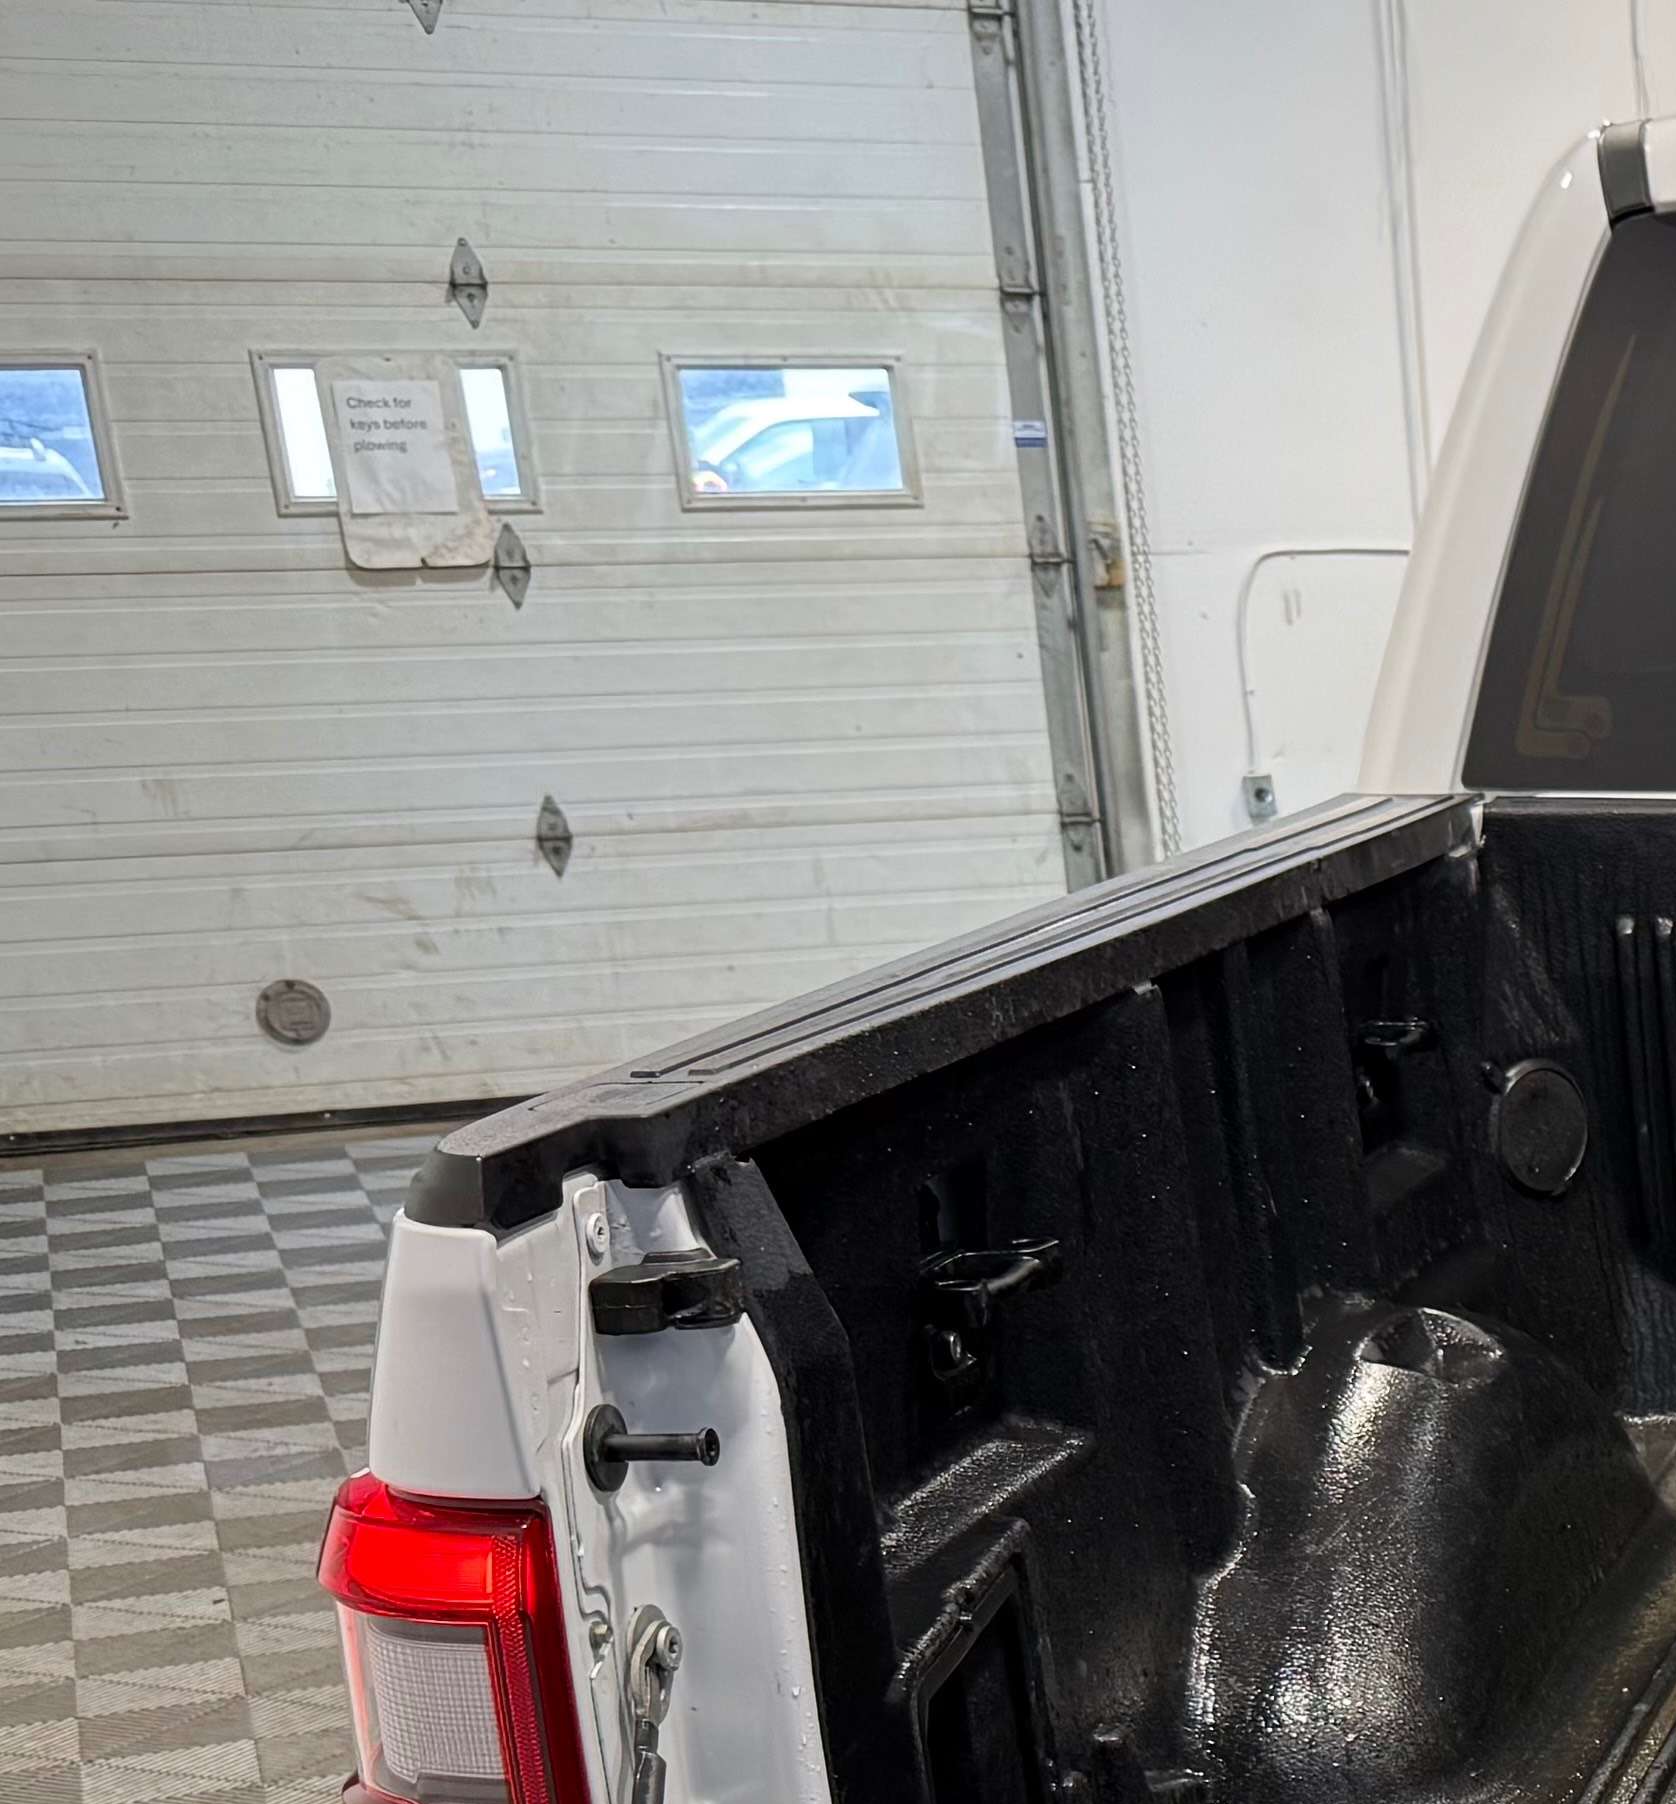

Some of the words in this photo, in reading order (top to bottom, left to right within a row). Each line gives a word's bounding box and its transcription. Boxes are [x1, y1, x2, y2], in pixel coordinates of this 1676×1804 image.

[345, 396, 391, 409] Check
[393, 396, 412, 409] for
[349, 418, 381, 432] keys
[383, 419, 428, 430] before
[352, 439, 408, 454] plowing
